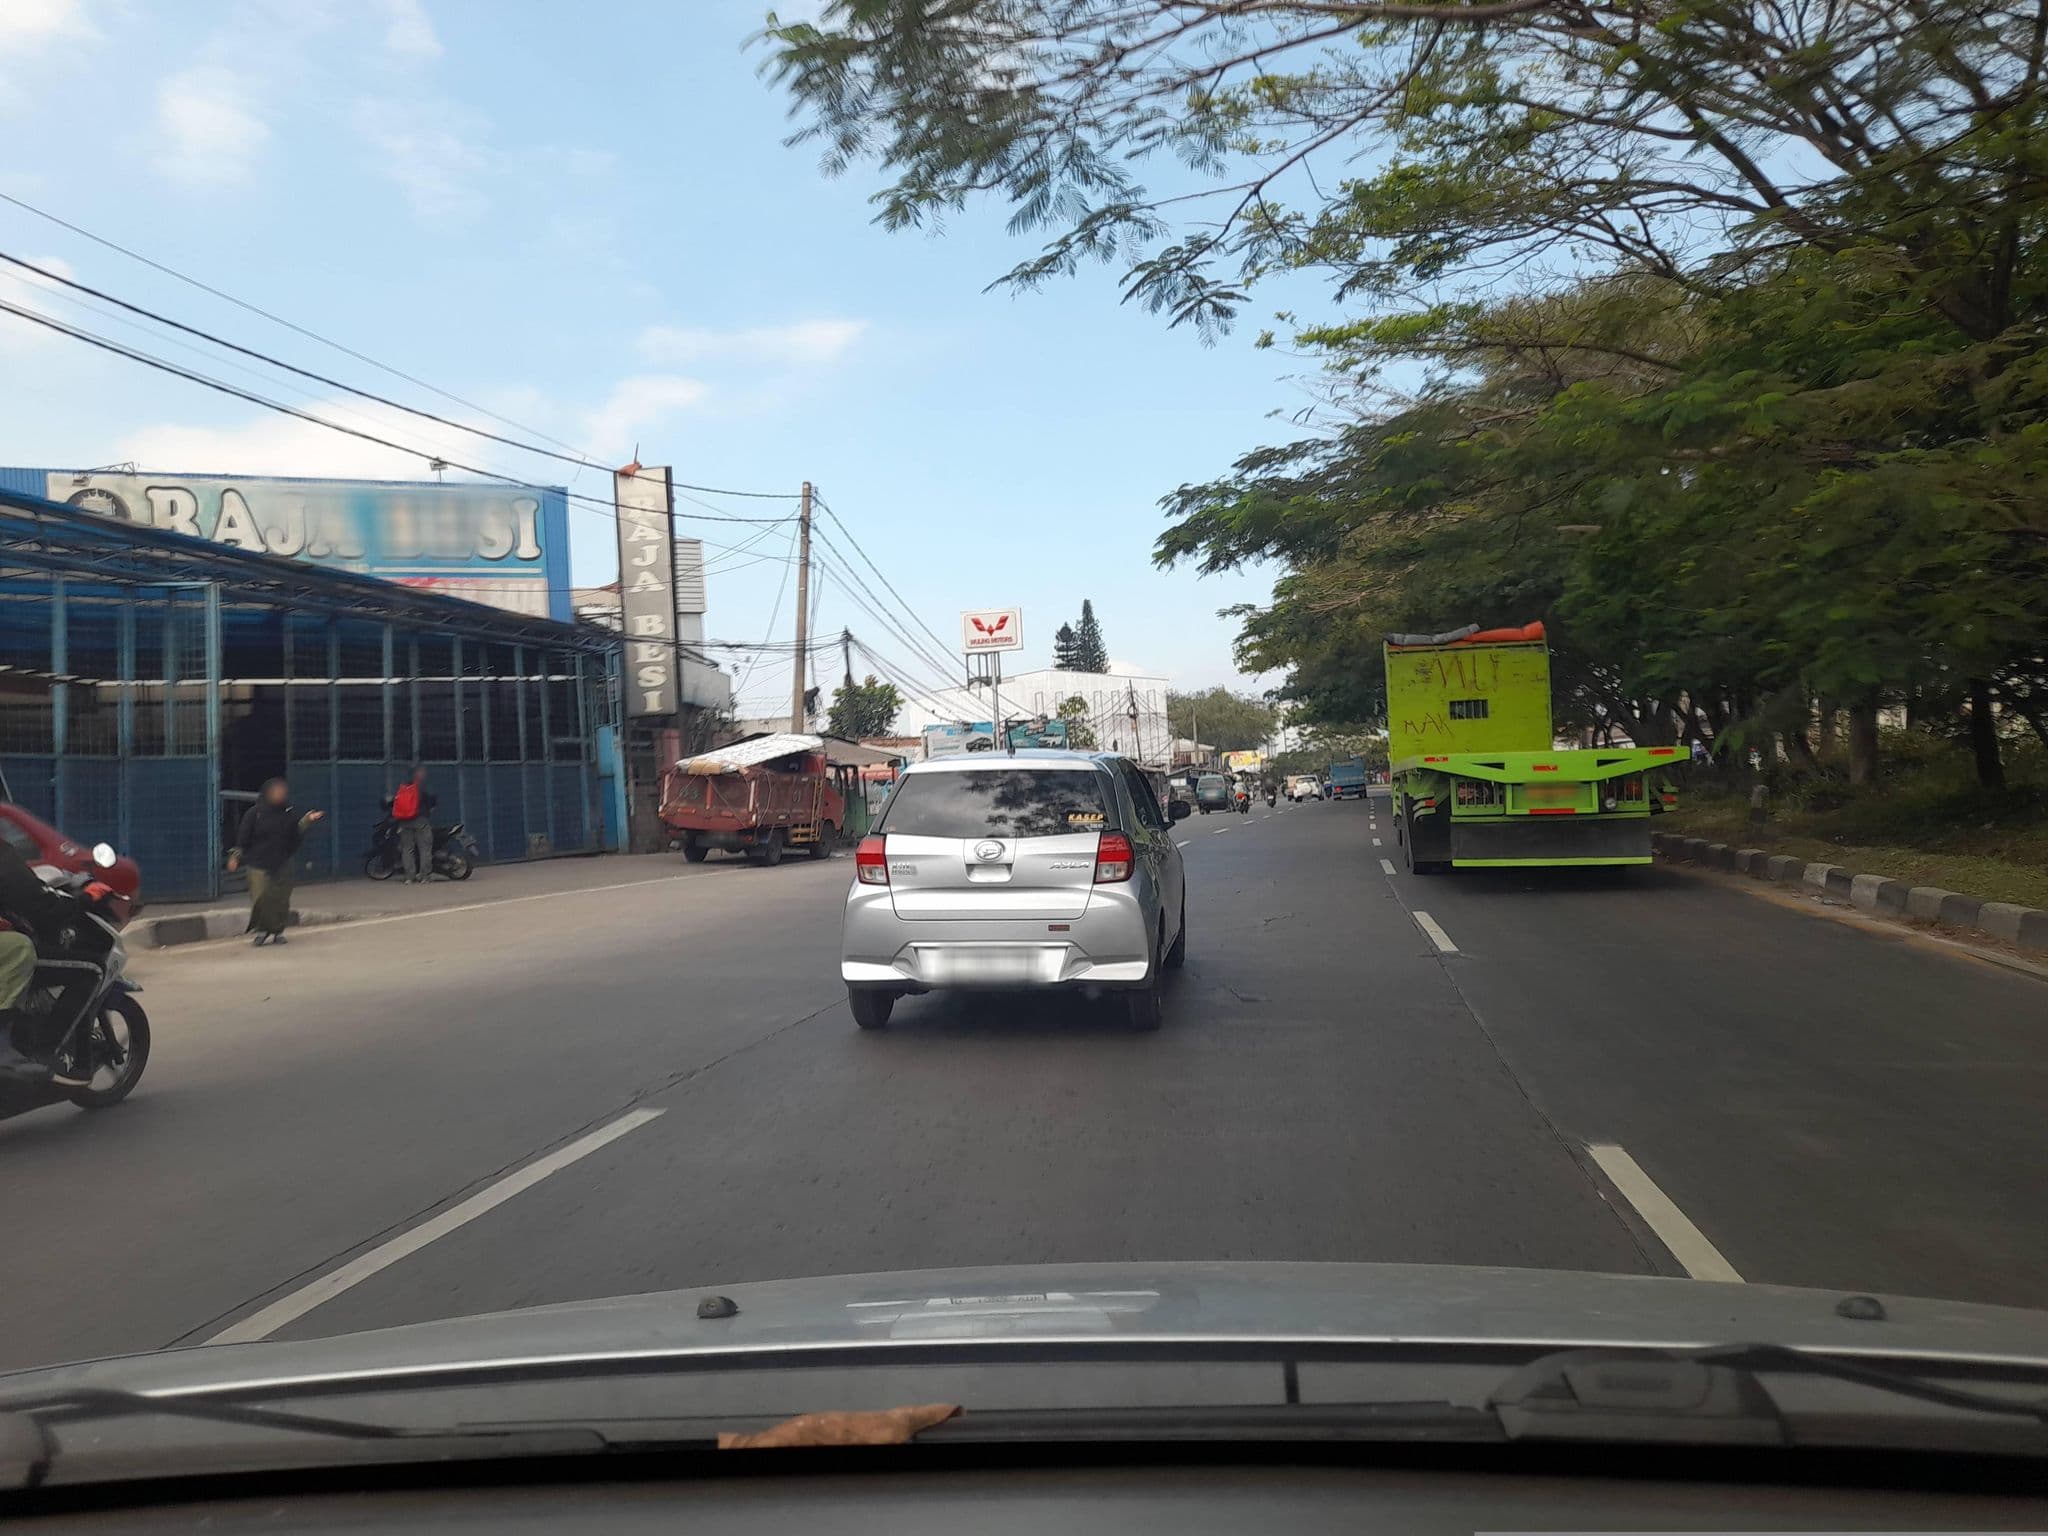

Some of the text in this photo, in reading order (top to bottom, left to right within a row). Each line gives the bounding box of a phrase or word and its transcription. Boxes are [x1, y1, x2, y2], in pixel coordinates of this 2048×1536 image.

[144, 486, 367, 558] RAJ
[624, 497, 668, 713] RAJA BESI
[1049, 861, 1089, 869] AYLA
